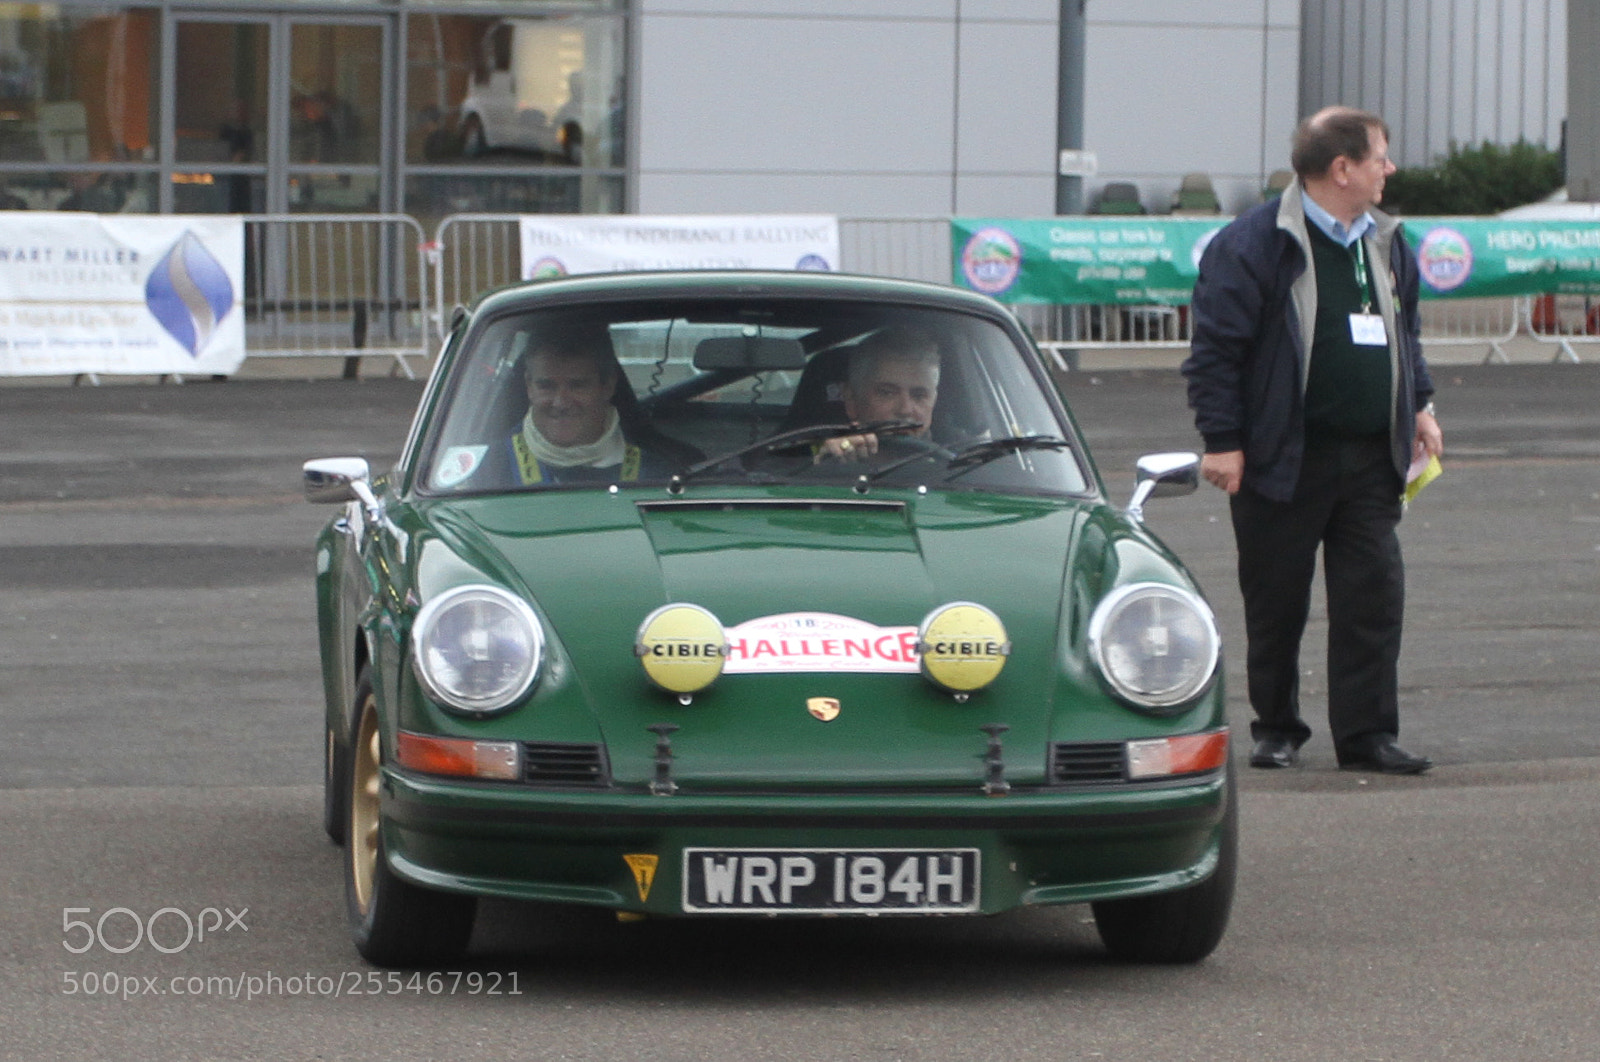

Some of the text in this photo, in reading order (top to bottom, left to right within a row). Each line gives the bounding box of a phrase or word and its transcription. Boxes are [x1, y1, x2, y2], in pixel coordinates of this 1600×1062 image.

[624, 226, 736, 244] ENDURANCE
[743, 226, 829, 243] RALLYING
[1487, 231, 1537, 251] HERO
[64, 247, 140, 265] MILLER
[652, 643, 716, 657] CIBIE
[725, 632, 917, 663] HALLENGE
[935, 641, 998, 655] CIBIE
[702, 856, 964, 905] WRP 184H
